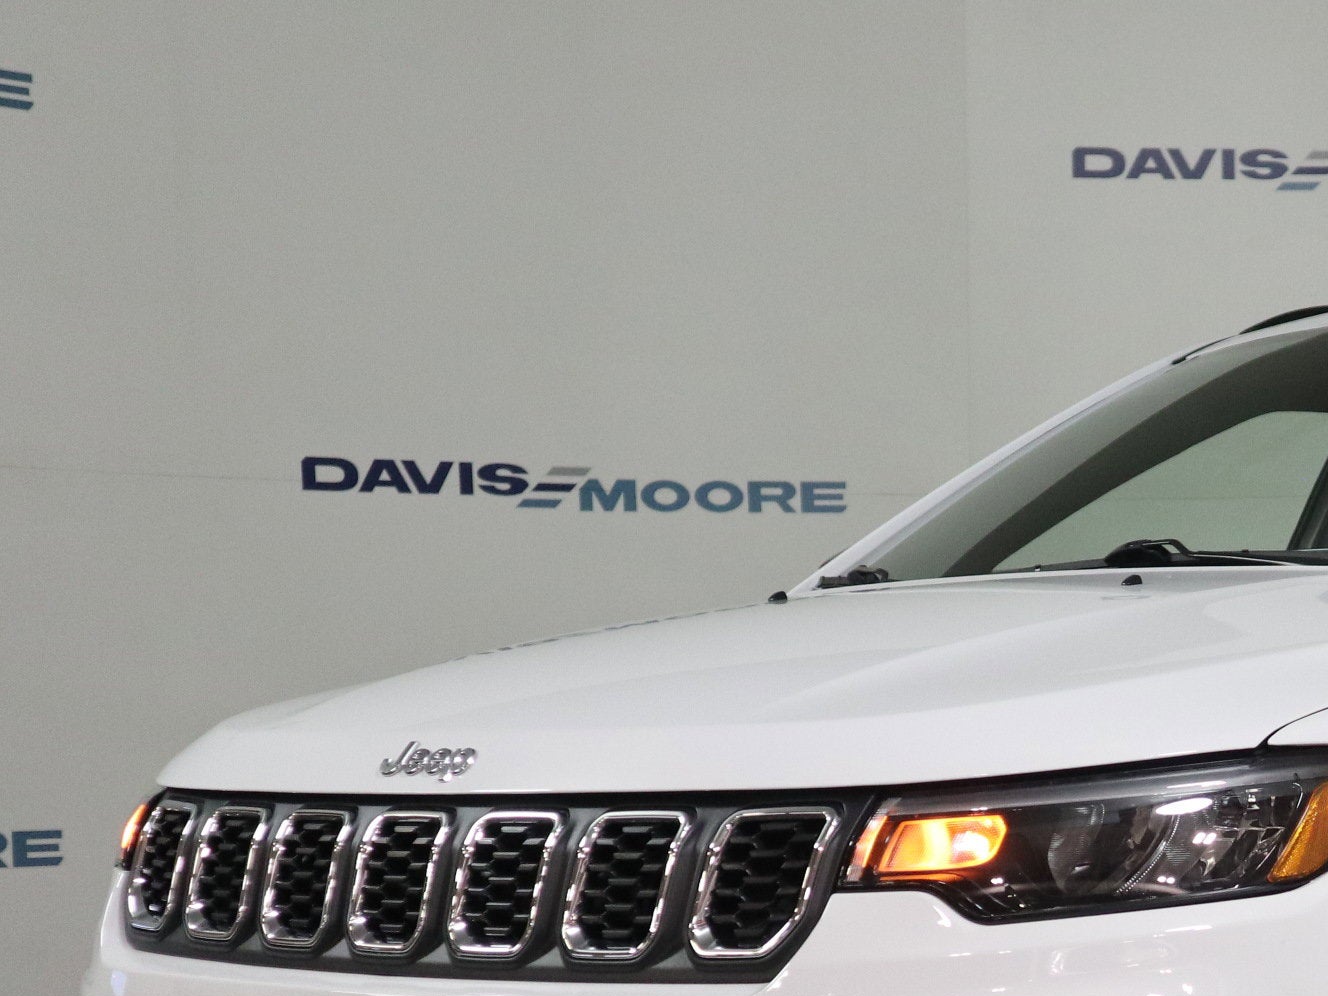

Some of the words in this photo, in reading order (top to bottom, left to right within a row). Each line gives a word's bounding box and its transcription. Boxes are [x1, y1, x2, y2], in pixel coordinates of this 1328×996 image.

[1072, 146, 1289, 180] DAVIS
[301, 456, 529, 496] DAVIS
[579, 478, 847, 513] MOORE
[380, 741, 477, 783] Jeep
